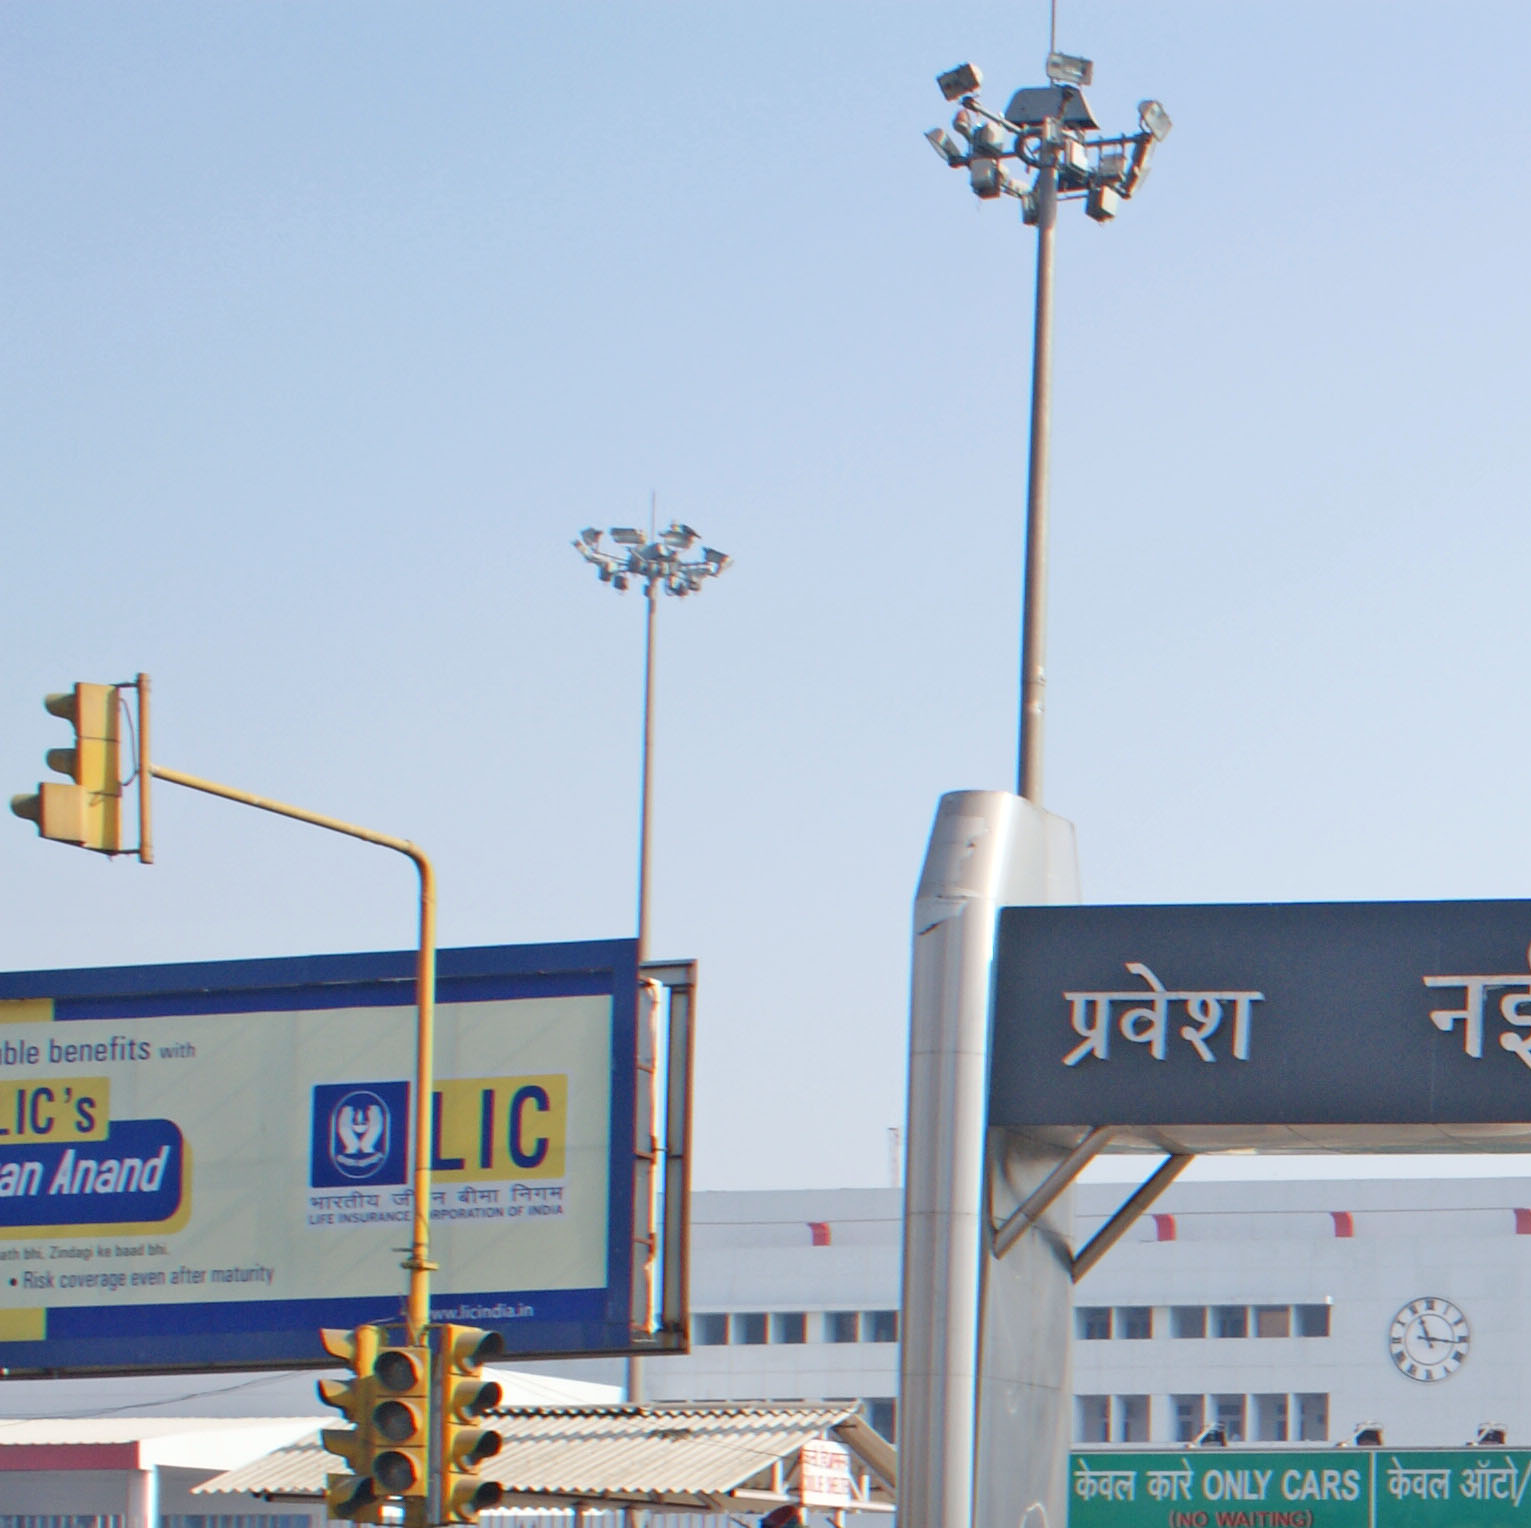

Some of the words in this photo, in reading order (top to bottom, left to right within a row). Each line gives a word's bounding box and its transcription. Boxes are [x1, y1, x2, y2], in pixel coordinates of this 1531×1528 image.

[1062, 963, 1265, 1066] प्रवेश
[0, 1039, 39, 1065] ble
[49, 1035, 151, 1064] benefits
[159, 1042, 196, 1059] with
[430, 1085, 551, 1171] LIC
[0, 1160, 43, 1197] an
[50, 1145, 171, 1195] Anand
[310, 1190, 380, 1210] भारतीय
[457, 1185, 500, 1204] बीमा
[509, 1183, 565, 1202] निगम
[309, 1213, 335, 1225] LIFE
[338, 1210, 411, 1223] INSURANCE
[429, 1207, 504, 1220] RPORATION
[507, 1206, 524, 1217] OF
[528, 1204, 564, 1216] INDIA
[23, 1271, 54, 1289] Risk
[59, 1272, 126, 1291] coverage
[131, 1269, 165, 1286] even
[169, 1265, 207, 1285] after
[210, 1263, 274, 1285] maturity
[430, 1303, 534, 1320] ww.licindia.in
[1073, 1457, 1137, 1501] केवल
[1202, 1469, 1273, 1501] ONLY
[1281, 1469, 1361, 1501] CARS
[1387, 1456, 1451, 1500] केवल
[1168, 1510, 1208, 1528] (NO
[1215, 1509, 1314, 1528] WAITING)
